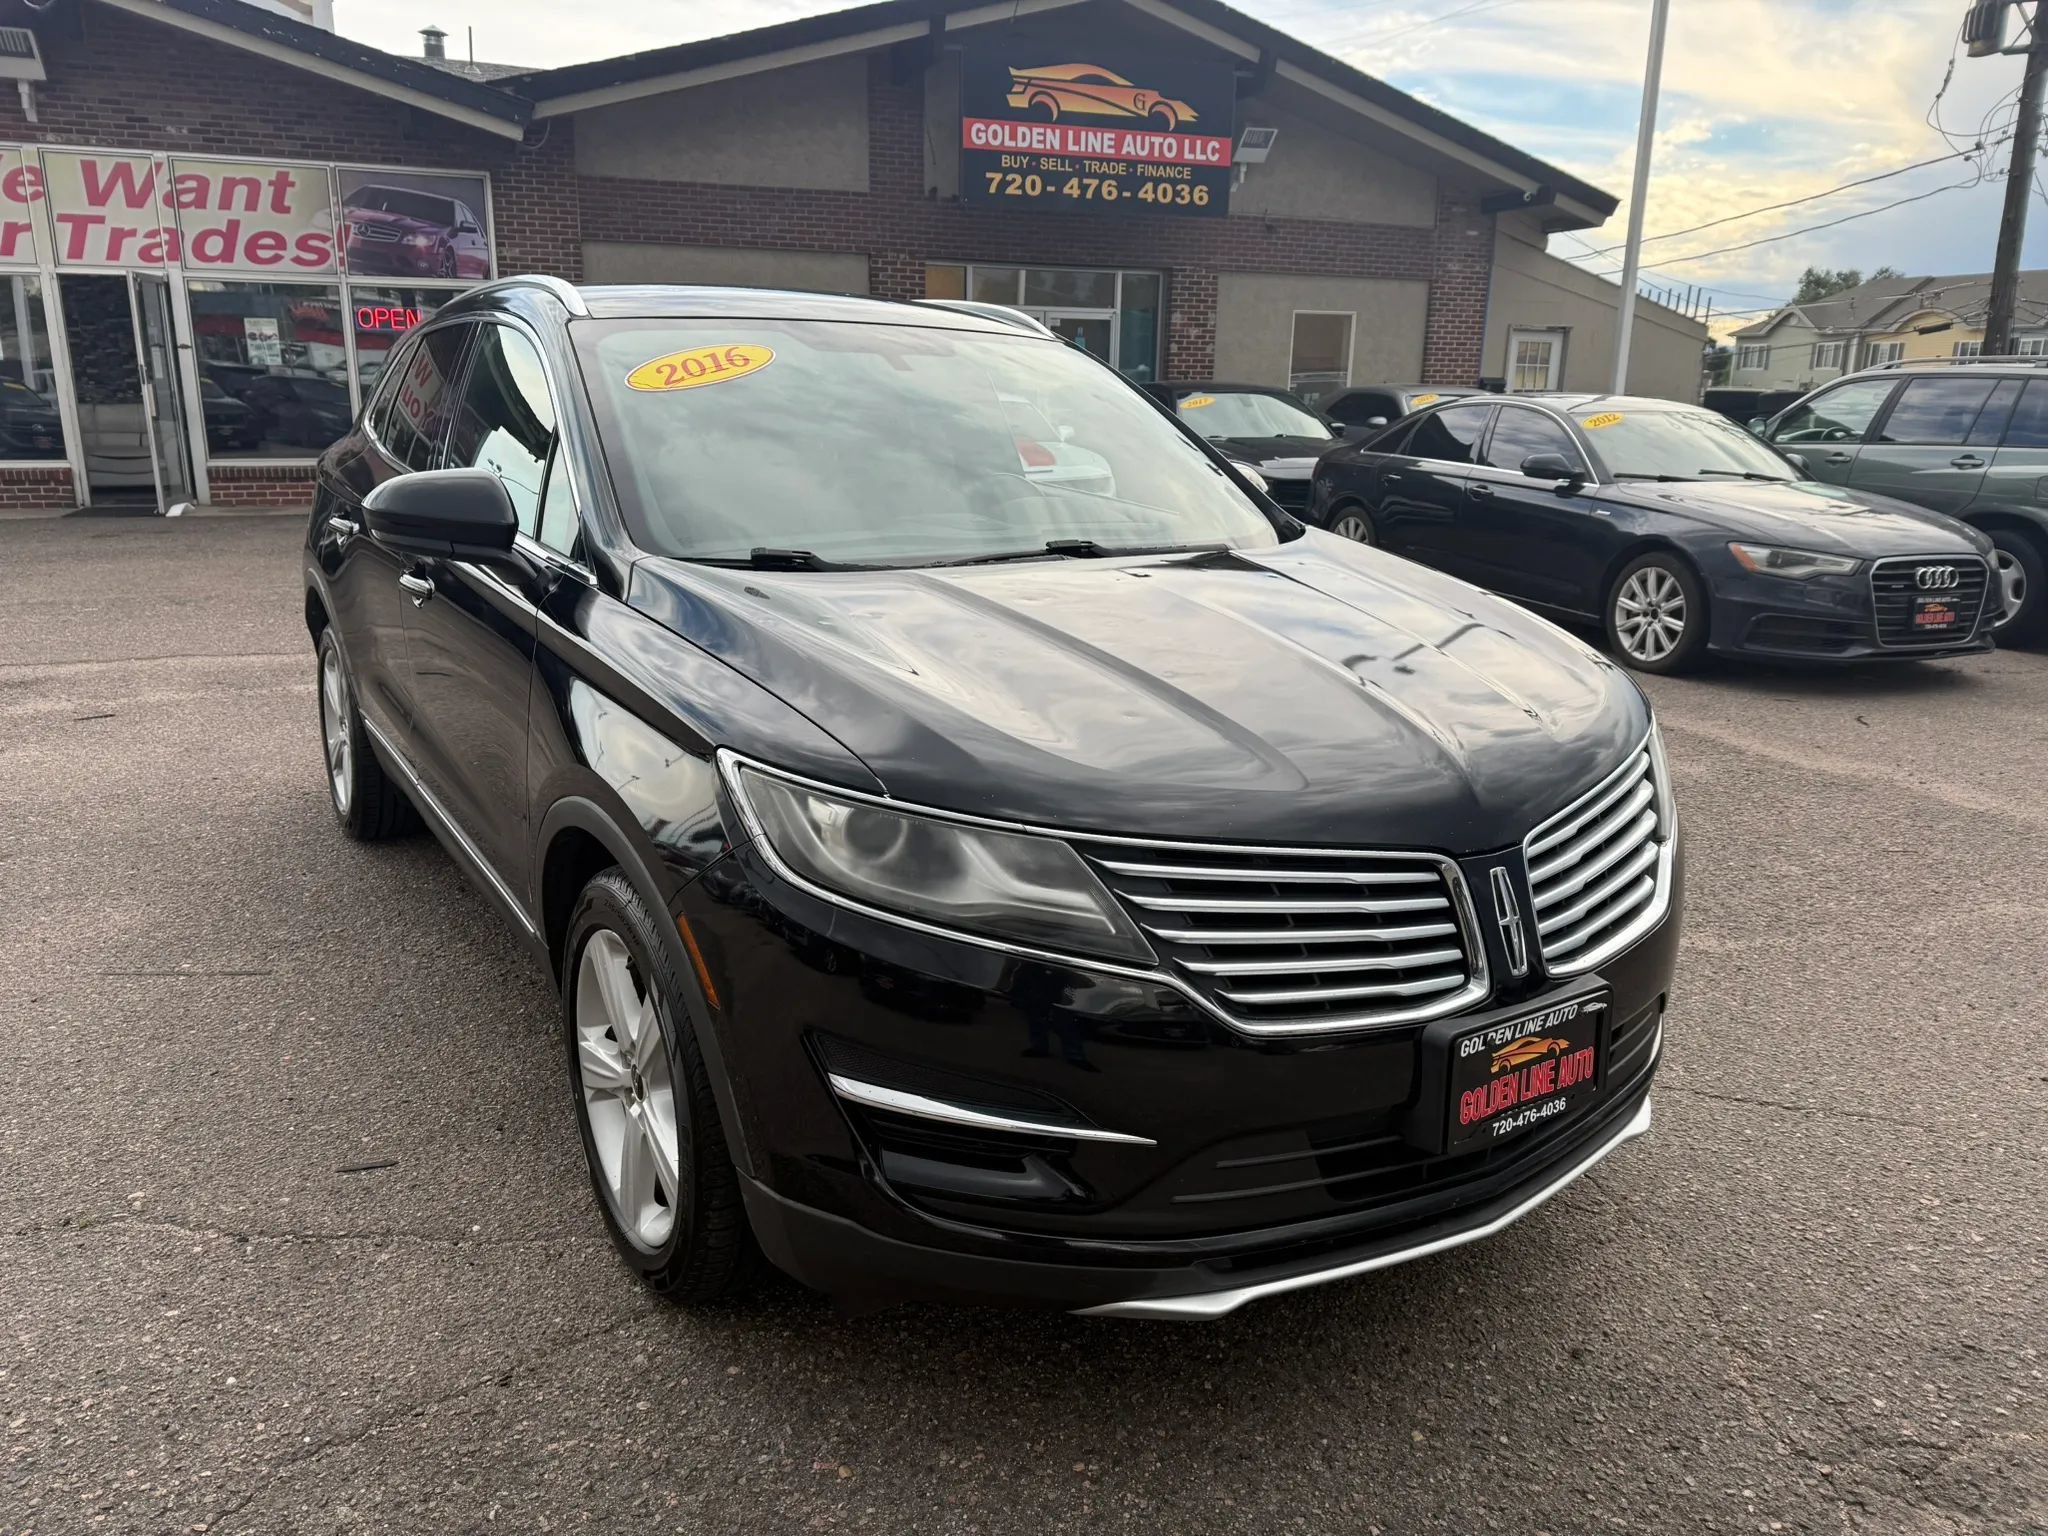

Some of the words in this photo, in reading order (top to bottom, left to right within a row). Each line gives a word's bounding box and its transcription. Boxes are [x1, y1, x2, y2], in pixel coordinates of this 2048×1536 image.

[970, 122, 1061, 151] GOLDEN
[1067, 130, 1115, 155] LINE
[1121, 134, 1178, 159] AUTO
[1183, 138, 1221, 162] LLC
[0, 154, 45, 203] e
[80, 159, 296, 214] Want
[1001, 155, 1030, 169] BUY
[1039, 157, 1073, 172] SELL
[1083, 160, 1127, 176] TRADE
[1137, 164, 1191, 180] FINANCE
[56, 213, 352, 267] Trades!
[358, 307, 422, 330] OPEN
[655, 346, 750, 386] 2016
[1588, 413, 1620, 427] 2012
[1515, 1015, 1545, 1038] LINE
[1545, 1004, 1578, 1028] AUTO
[1459, 1071, 1520, 1125] GOLDEN
[1520, 1058, 1555, 1102] LINE
[1556, 1047, 1595, 1090] AUTO
[1492, 1097, 1567, 1137] 720-476-4036
